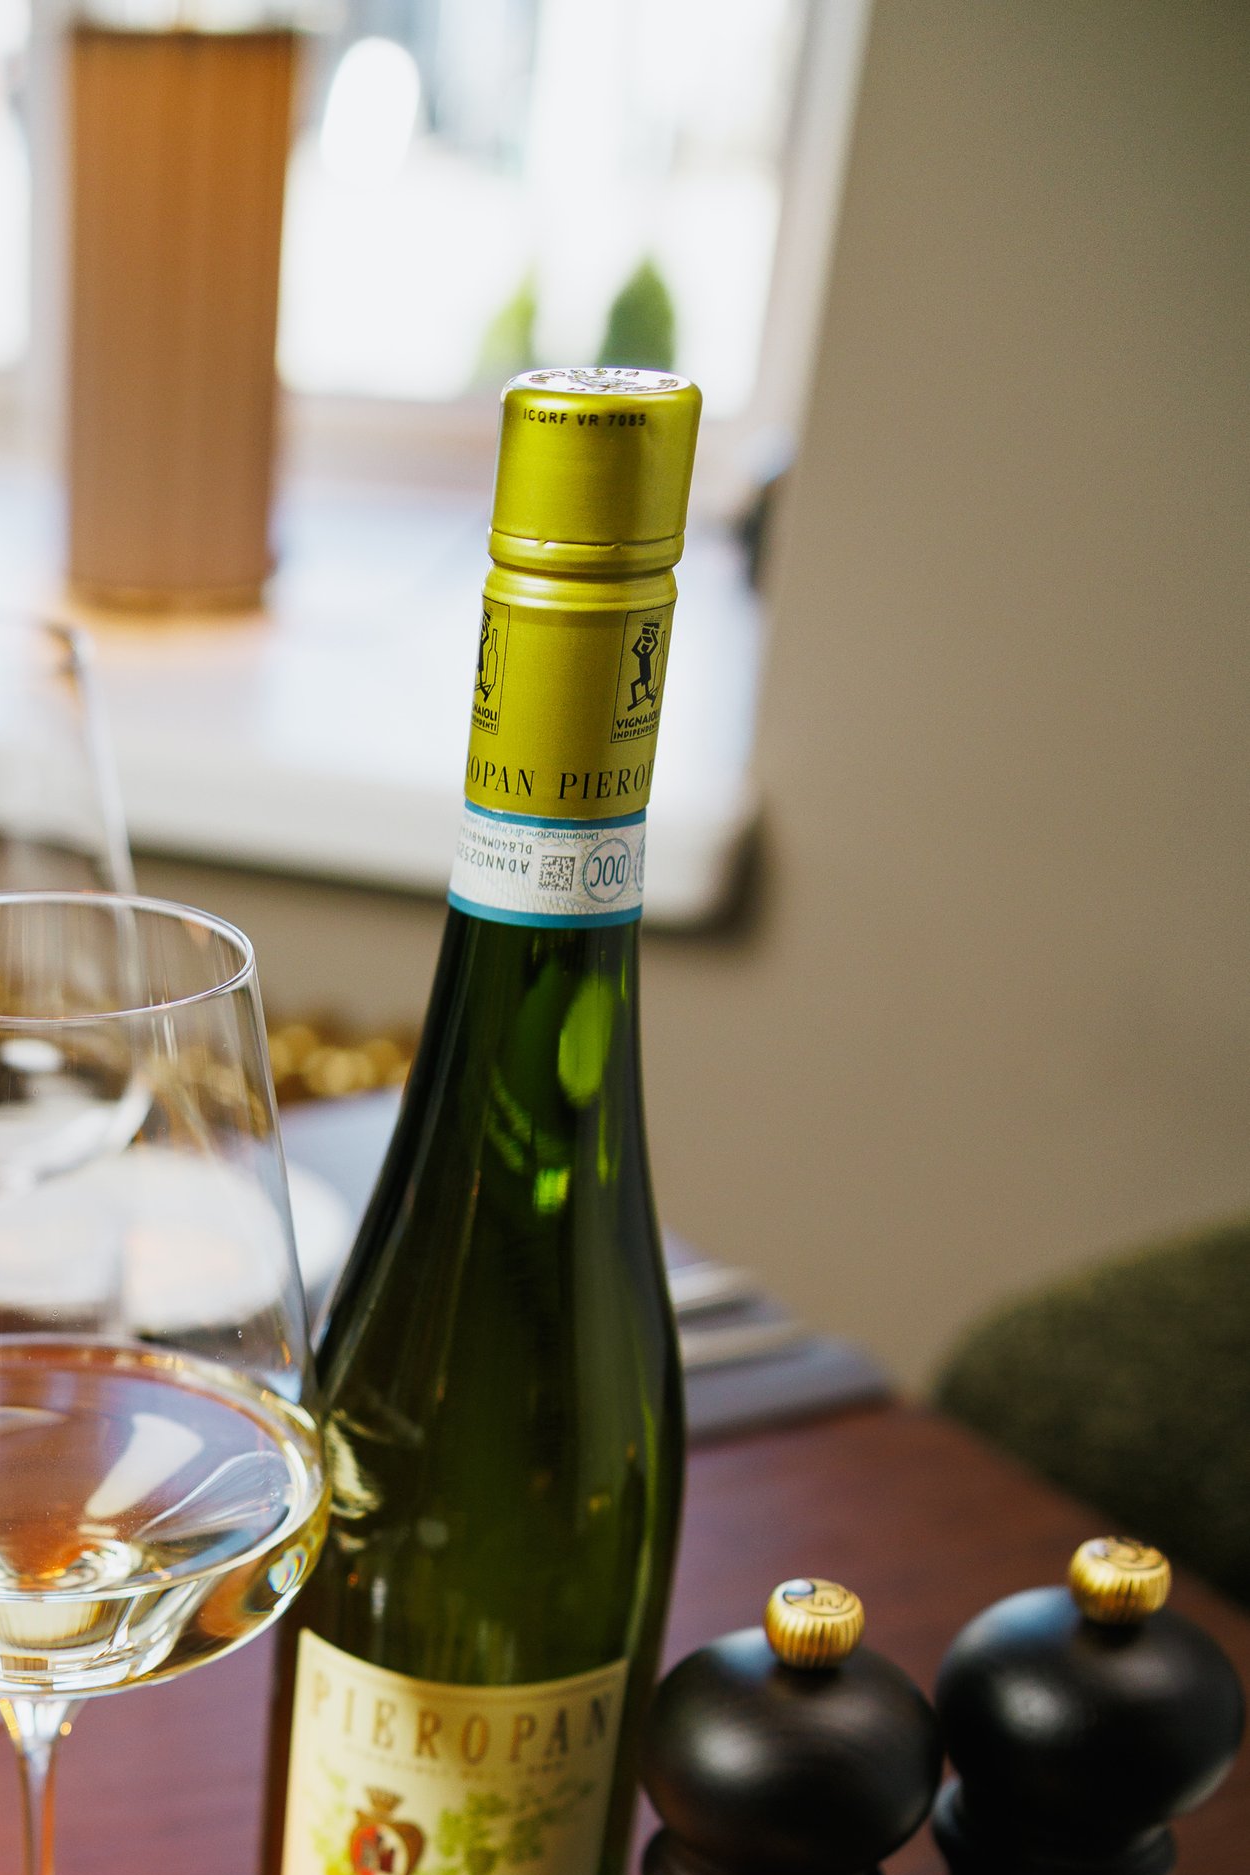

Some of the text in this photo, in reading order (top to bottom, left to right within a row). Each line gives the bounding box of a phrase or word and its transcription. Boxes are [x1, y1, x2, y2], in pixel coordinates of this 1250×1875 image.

[523, 408, 647, 427] ICQRF VR 7085
[472, 704, 497, 721] NAIOLI
[467, 751, 535, 797] OPAN
[589, 853, 626, 888] DOC
[309, 1670, 611, 1766] PIEROPAN
